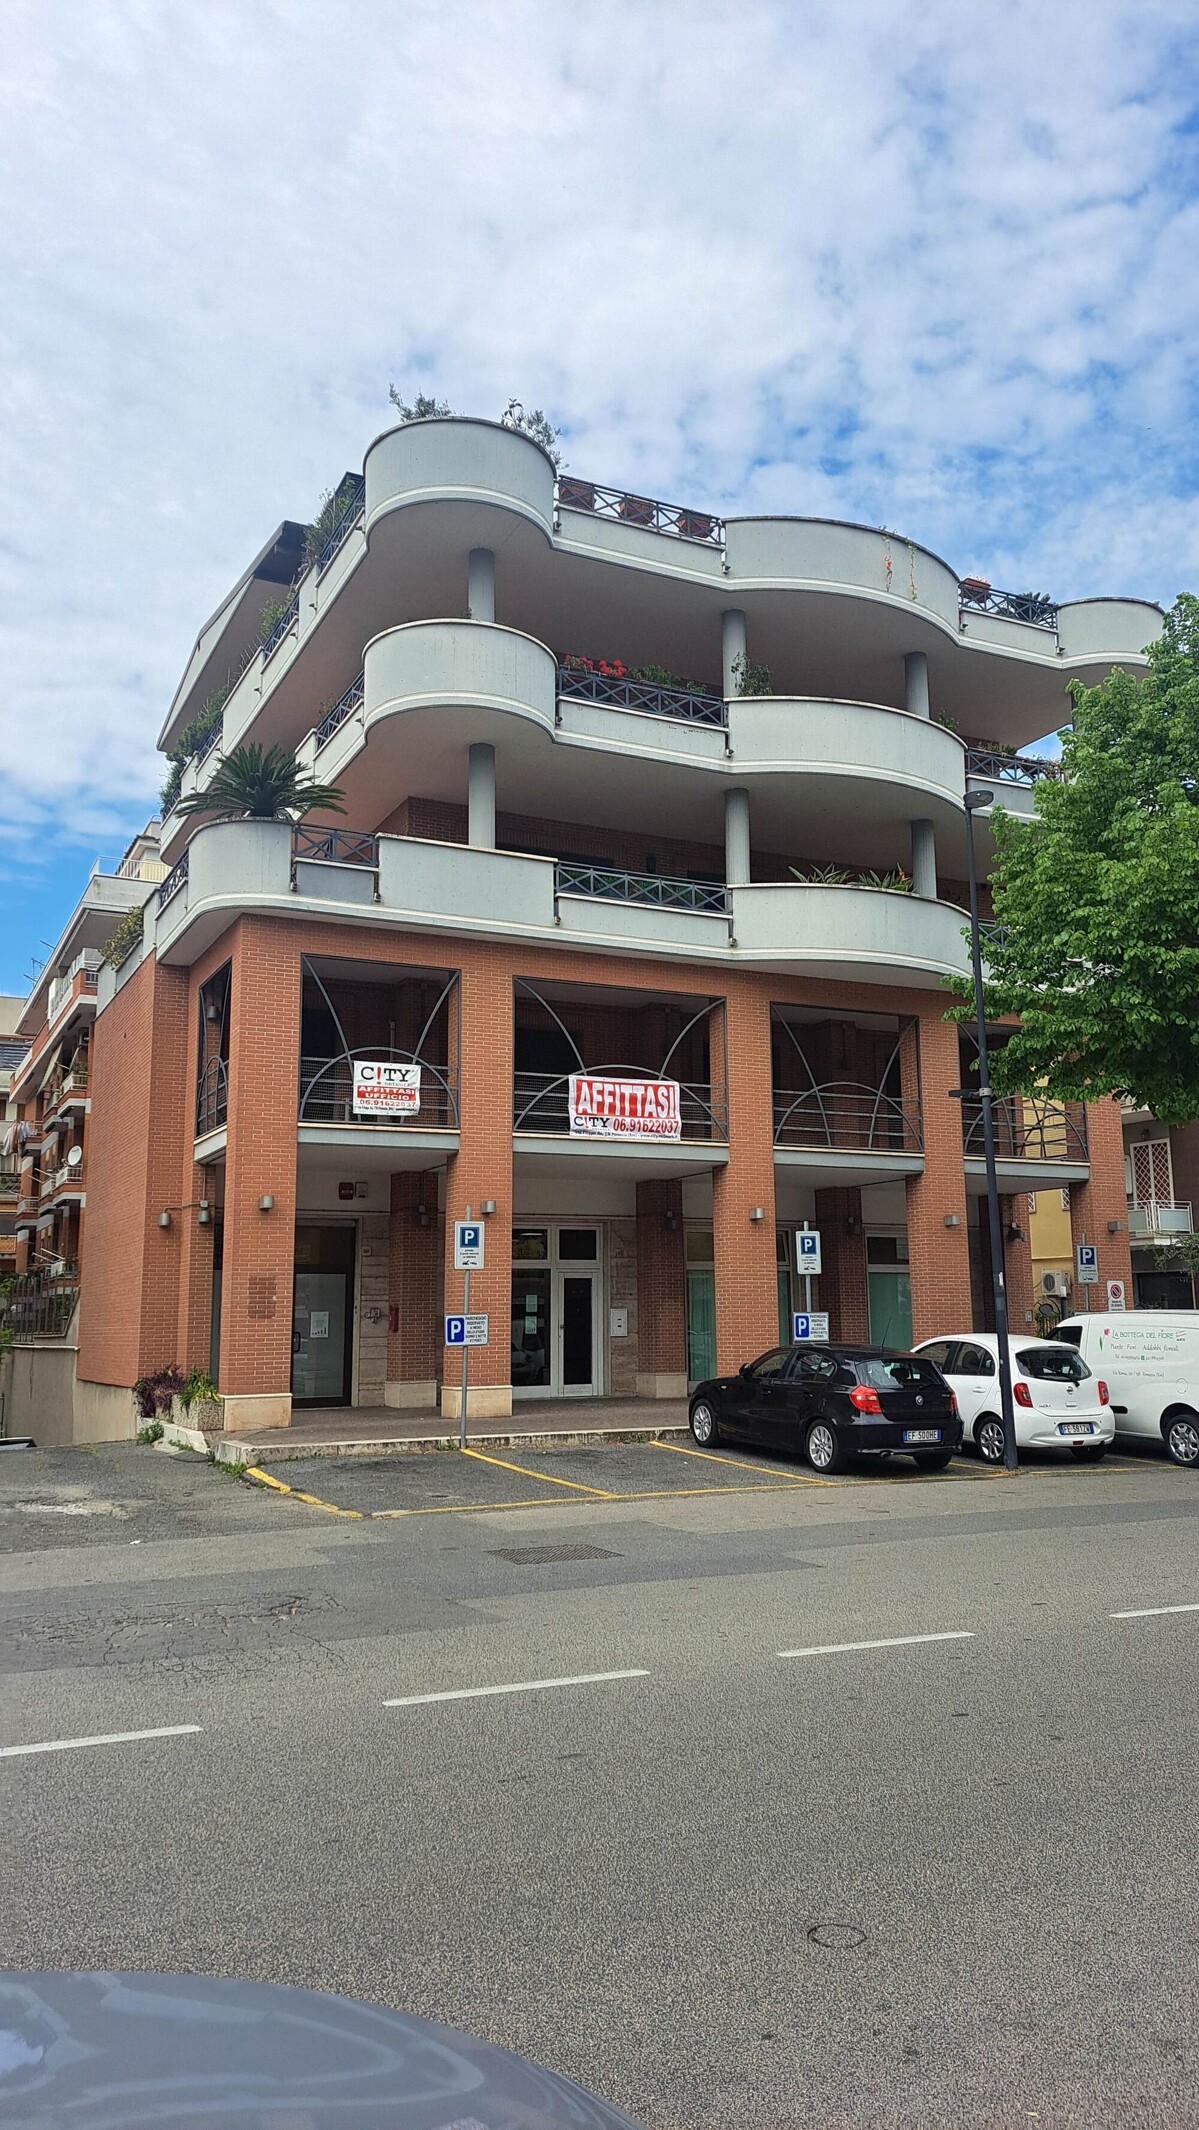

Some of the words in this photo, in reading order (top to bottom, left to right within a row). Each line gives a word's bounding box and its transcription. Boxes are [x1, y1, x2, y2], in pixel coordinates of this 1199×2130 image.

[358, 1086, 415, 1095] AFFITTASI
[364, 1092, 410, 1101] UFFICIO
[359, 1099, 416, 1108] 06.91622037
[578, 1082, 674, 1118] AFFITTASI
[613, 1118, 679, 1134] 06.91622037
[464, 1229, 475, 1245] P
[804, 1239, 812, 1252] P
[1082, 1248, 1092, 1264] P
[451, 1320, 462, 1340] P
[798, 1318, 807, 1336] P
[1120, 1331, 1144, 1339] BOTTEGA
[908, 1431, 917, 1440] EF
[918, 1430, 937, 1440] 500HE
